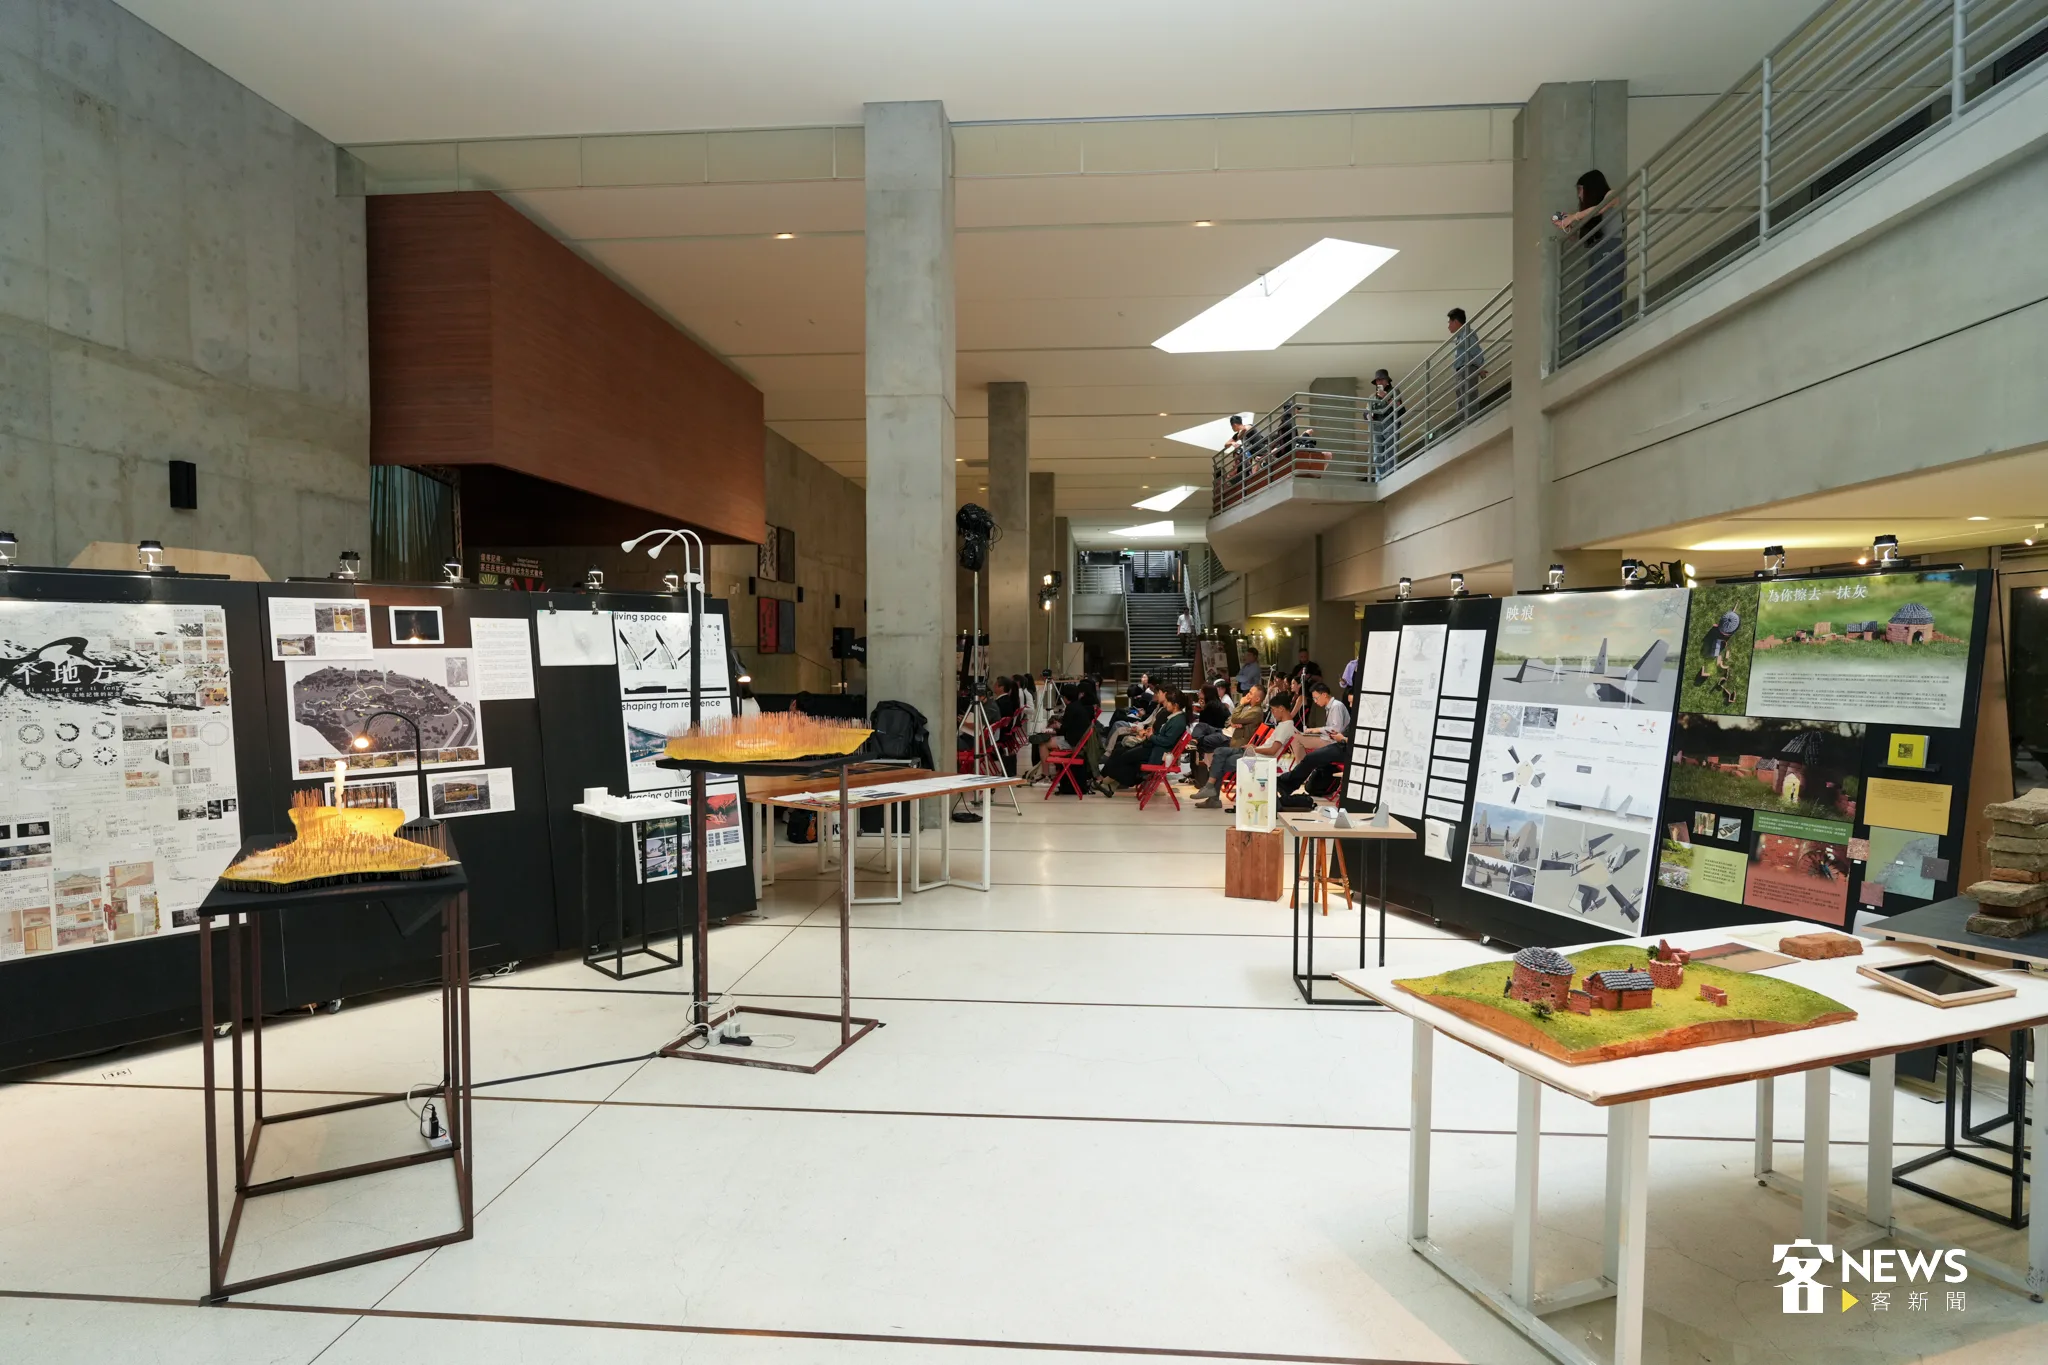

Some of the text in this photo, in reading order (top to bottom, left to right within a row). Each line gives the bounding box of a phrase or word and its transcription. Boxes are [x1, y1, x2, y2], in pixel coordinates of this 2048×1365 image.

[1767, 584, 1867, 602] 為你擦去一抹灰
[614, 612, 668, 622] living space
[1506, 604, 1534, 621] 映痕
[622, 699, 721, 711] shaping from refence
[664, 790, 672, 799] of
[674, 789, 692, 797] time
